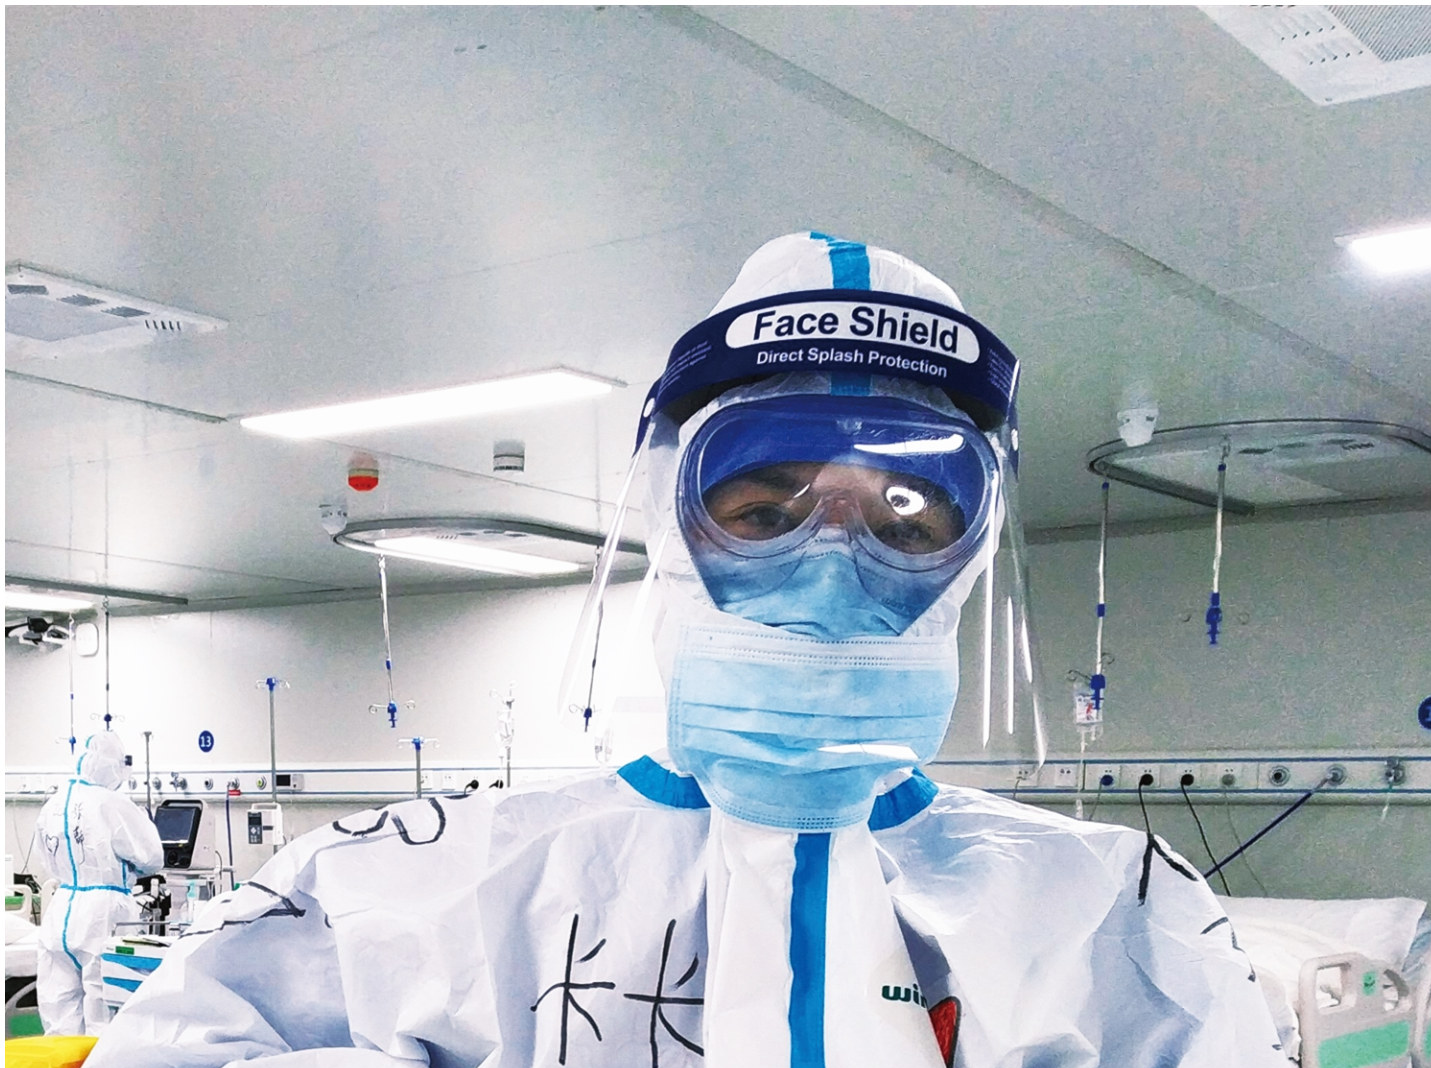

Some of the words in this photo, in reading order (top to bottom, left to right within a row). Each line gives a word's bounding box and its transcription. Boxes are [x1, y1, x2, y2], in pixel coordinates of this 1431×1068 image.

[753, 309, 839, 341] Face
[849, 306, 959, 353] Shield
[756, 349, 803, 365] Direct
[807, 347, 864, 365] Splash
[867, 350, 948, 378] Protection
[199, 735, 212, 748] 13
